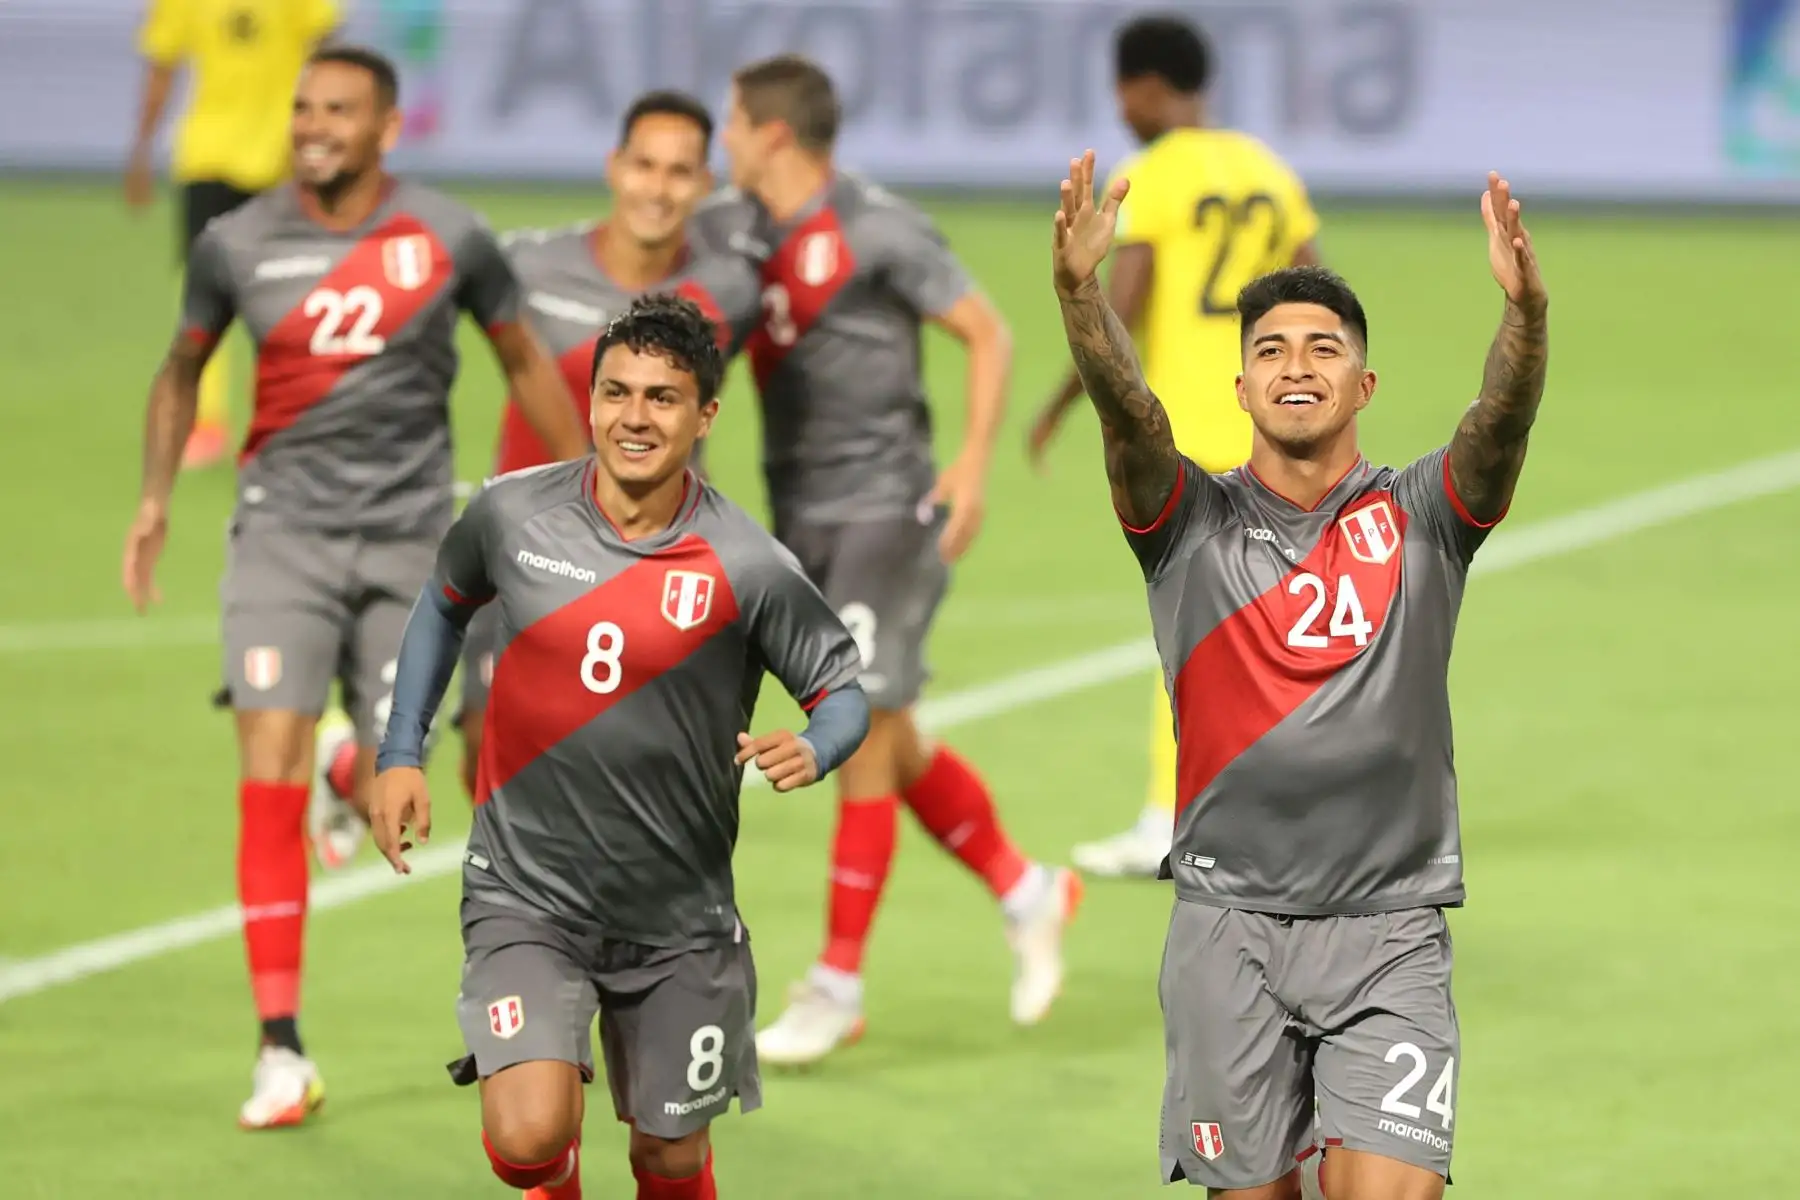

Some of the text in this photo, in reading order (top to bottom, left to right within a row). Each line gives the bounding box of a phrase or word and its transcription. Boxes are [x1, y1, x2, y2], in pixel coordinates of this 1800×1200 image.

[304, 285, 386, 356] 22
[517, 549, 597, 583] marathon
[1287, 572, 1373, 648] 24
[580, 621, 625, 694] 8
[687, 1025, 725, 1091] 8
[1380, 1042, 1454, 1130] 24
[1378, 1118, 1449, 1152] marathon
